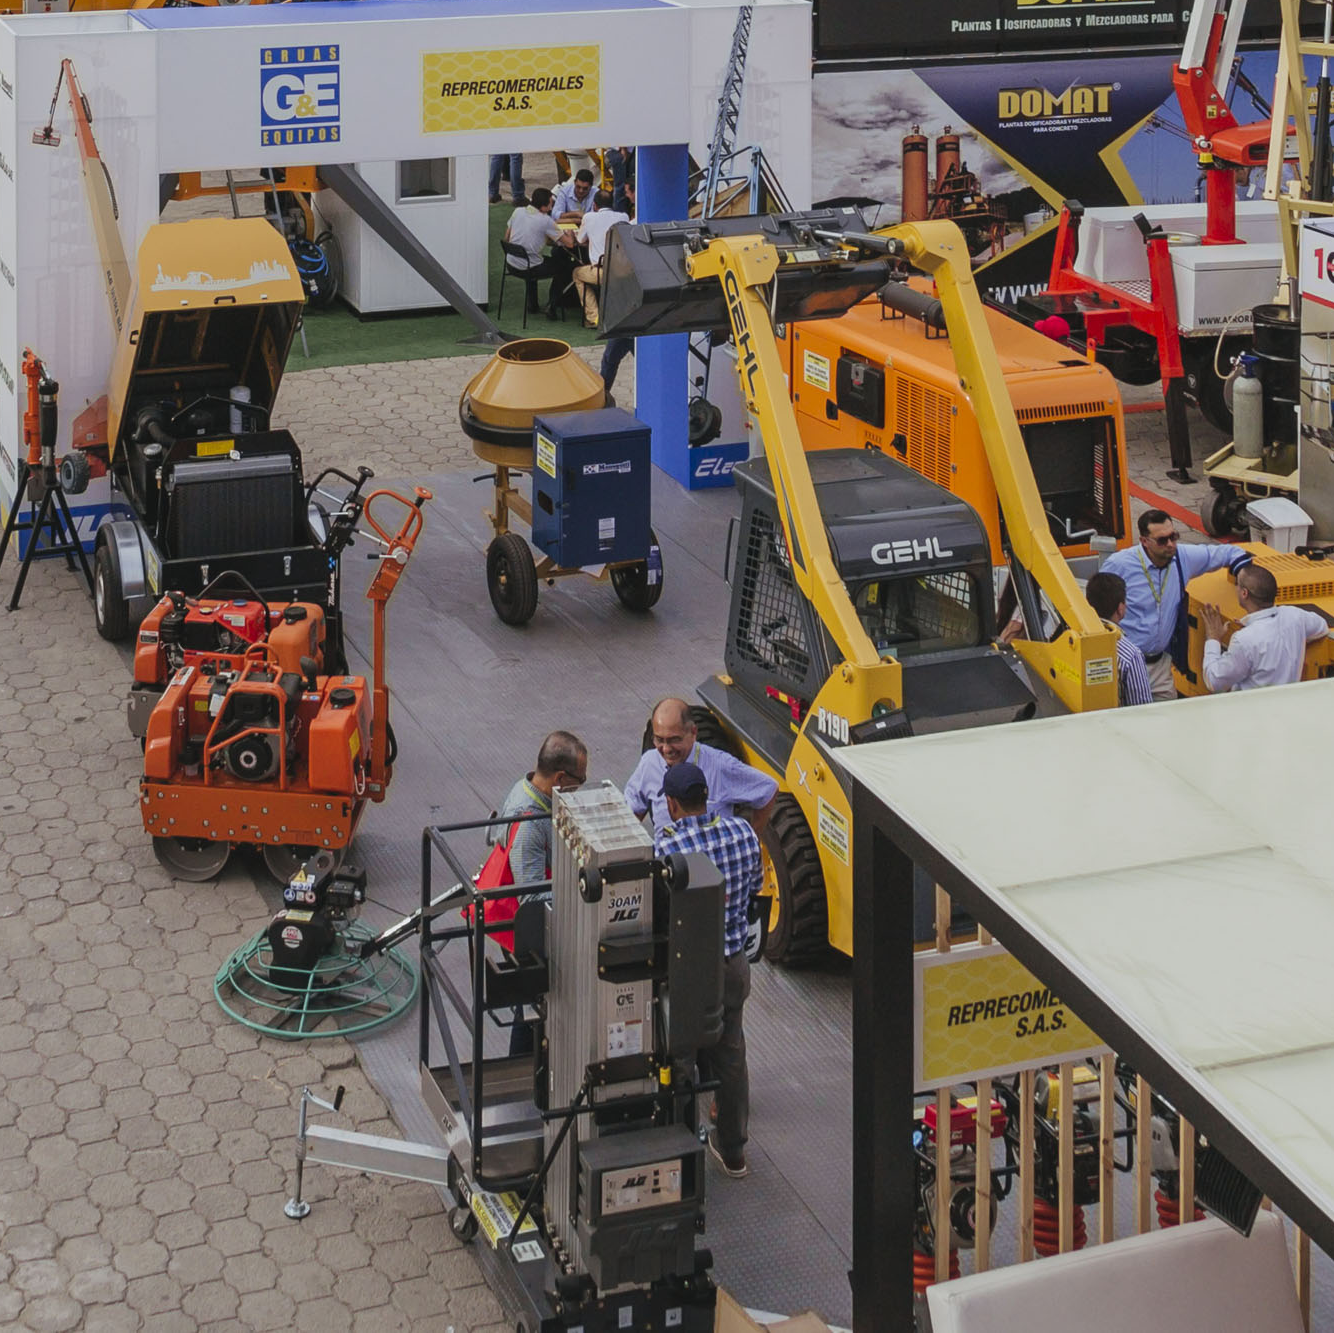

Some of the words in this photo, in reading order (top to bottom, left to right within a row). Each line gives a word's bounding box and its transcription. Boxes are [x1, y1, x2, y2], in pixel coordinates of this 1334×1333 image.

[264, 46, 338, 64] GRUAS
[441, 75, 585, 97] REPRECOMERCIALES
[493, 95, 533, 111] S.A.S.
[998, 87, 1113, 119] DOMAT
[262, 126, 338, 145] EQUIPOS
[724, 269, 758, 398] GEHL
[870, 536, 954, 565] GEHL
[817, 706, 850, 746] R190
[608, 894, 642, 910] 30AM
[608, 908, 640, 923] JLG
[948, 990, 1065, 1027] REPRECOME
[1016, 1010, 1067, 1038] S.A.S.
